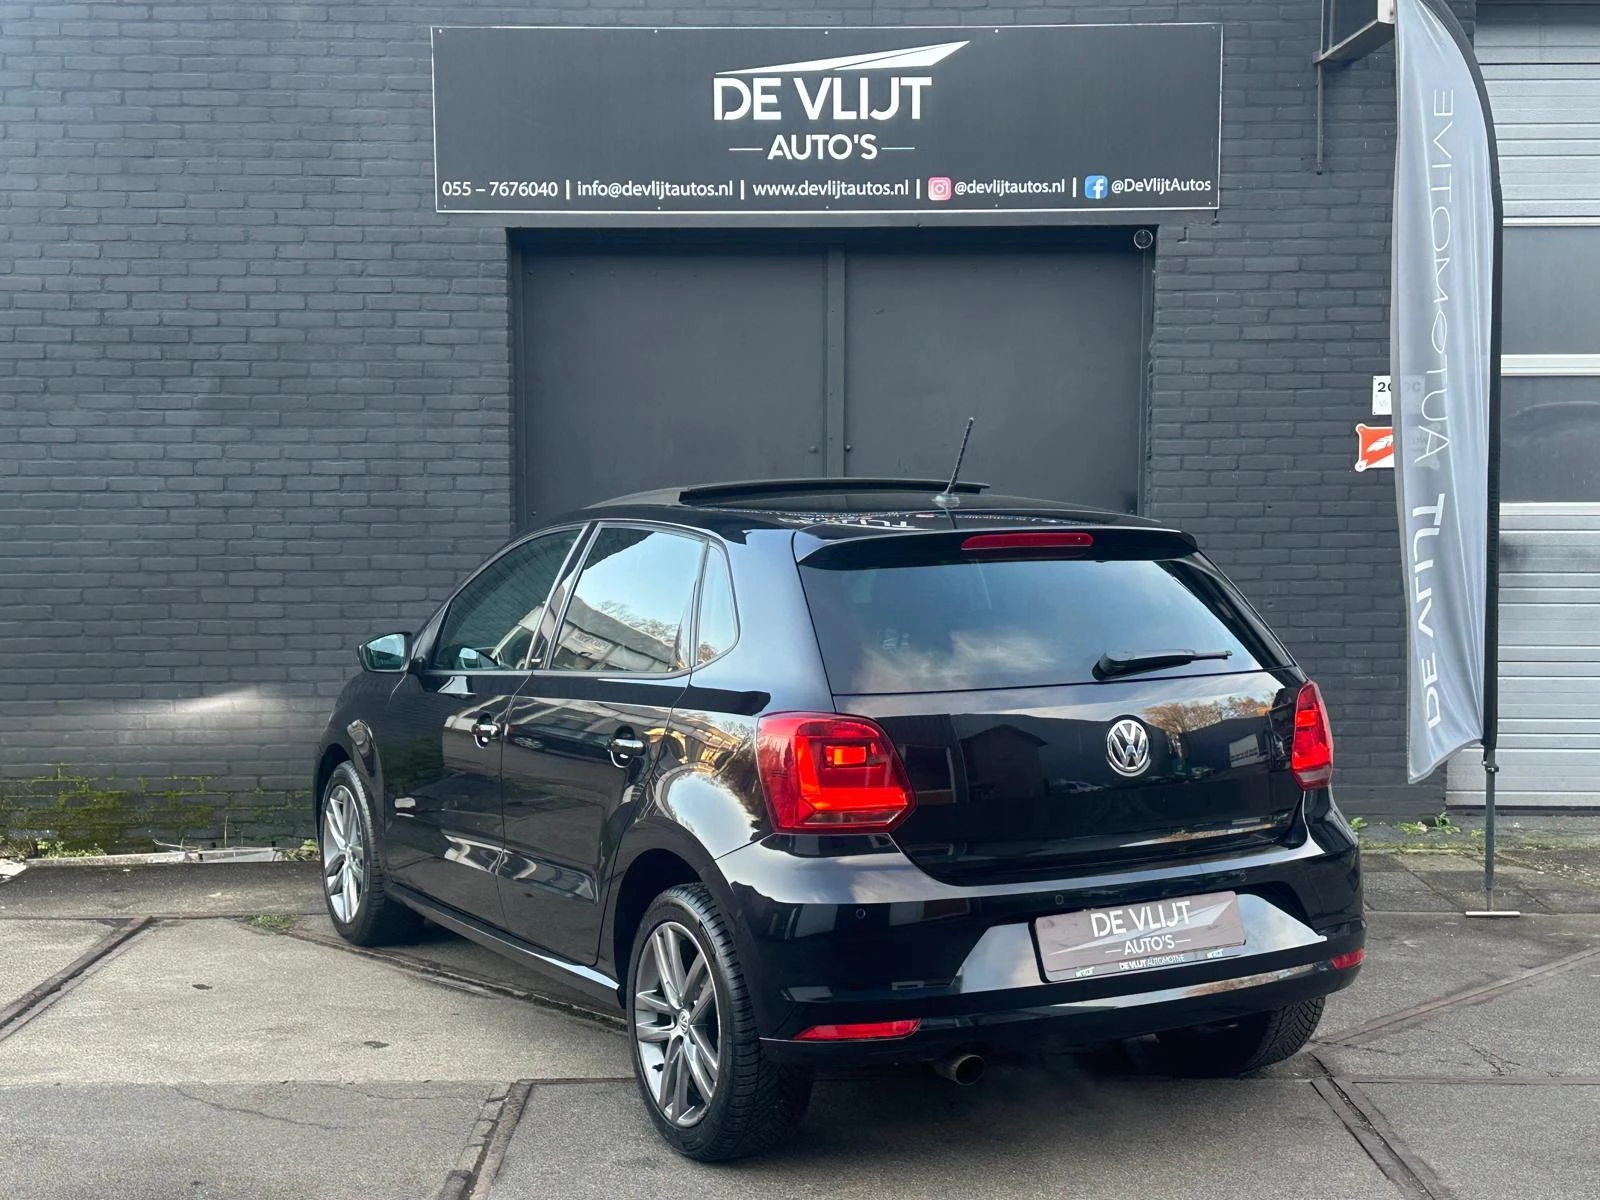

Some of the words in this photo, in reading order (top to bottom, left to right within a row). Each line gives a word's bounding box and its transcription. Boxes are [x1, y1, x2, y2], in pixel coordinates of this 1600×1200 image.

[713, 77, 782, 121] DE
[793, 76, 933, 121] VLIJT
[767, 133, 878, 161] AUTO'S
[442, 181, 472, 197] 055
[489, 181, 559, 197] 7676040
[577, 180, 733, 200] info@devlijtautos.nl
[752, 180, 909, 200] www.devlijtautos.nl
[954, 179, 1065, 197] @devlijtautos.nl
[1111, 177, 1212, 196] @DeVlijtAutos
[1090, 909, 1127, 937] DE
[1128, 901, 1191, 932] VLIJT
[1124, 934, 1175, 956] AUTO'S
[1119, 962, 1130, 970] DE
